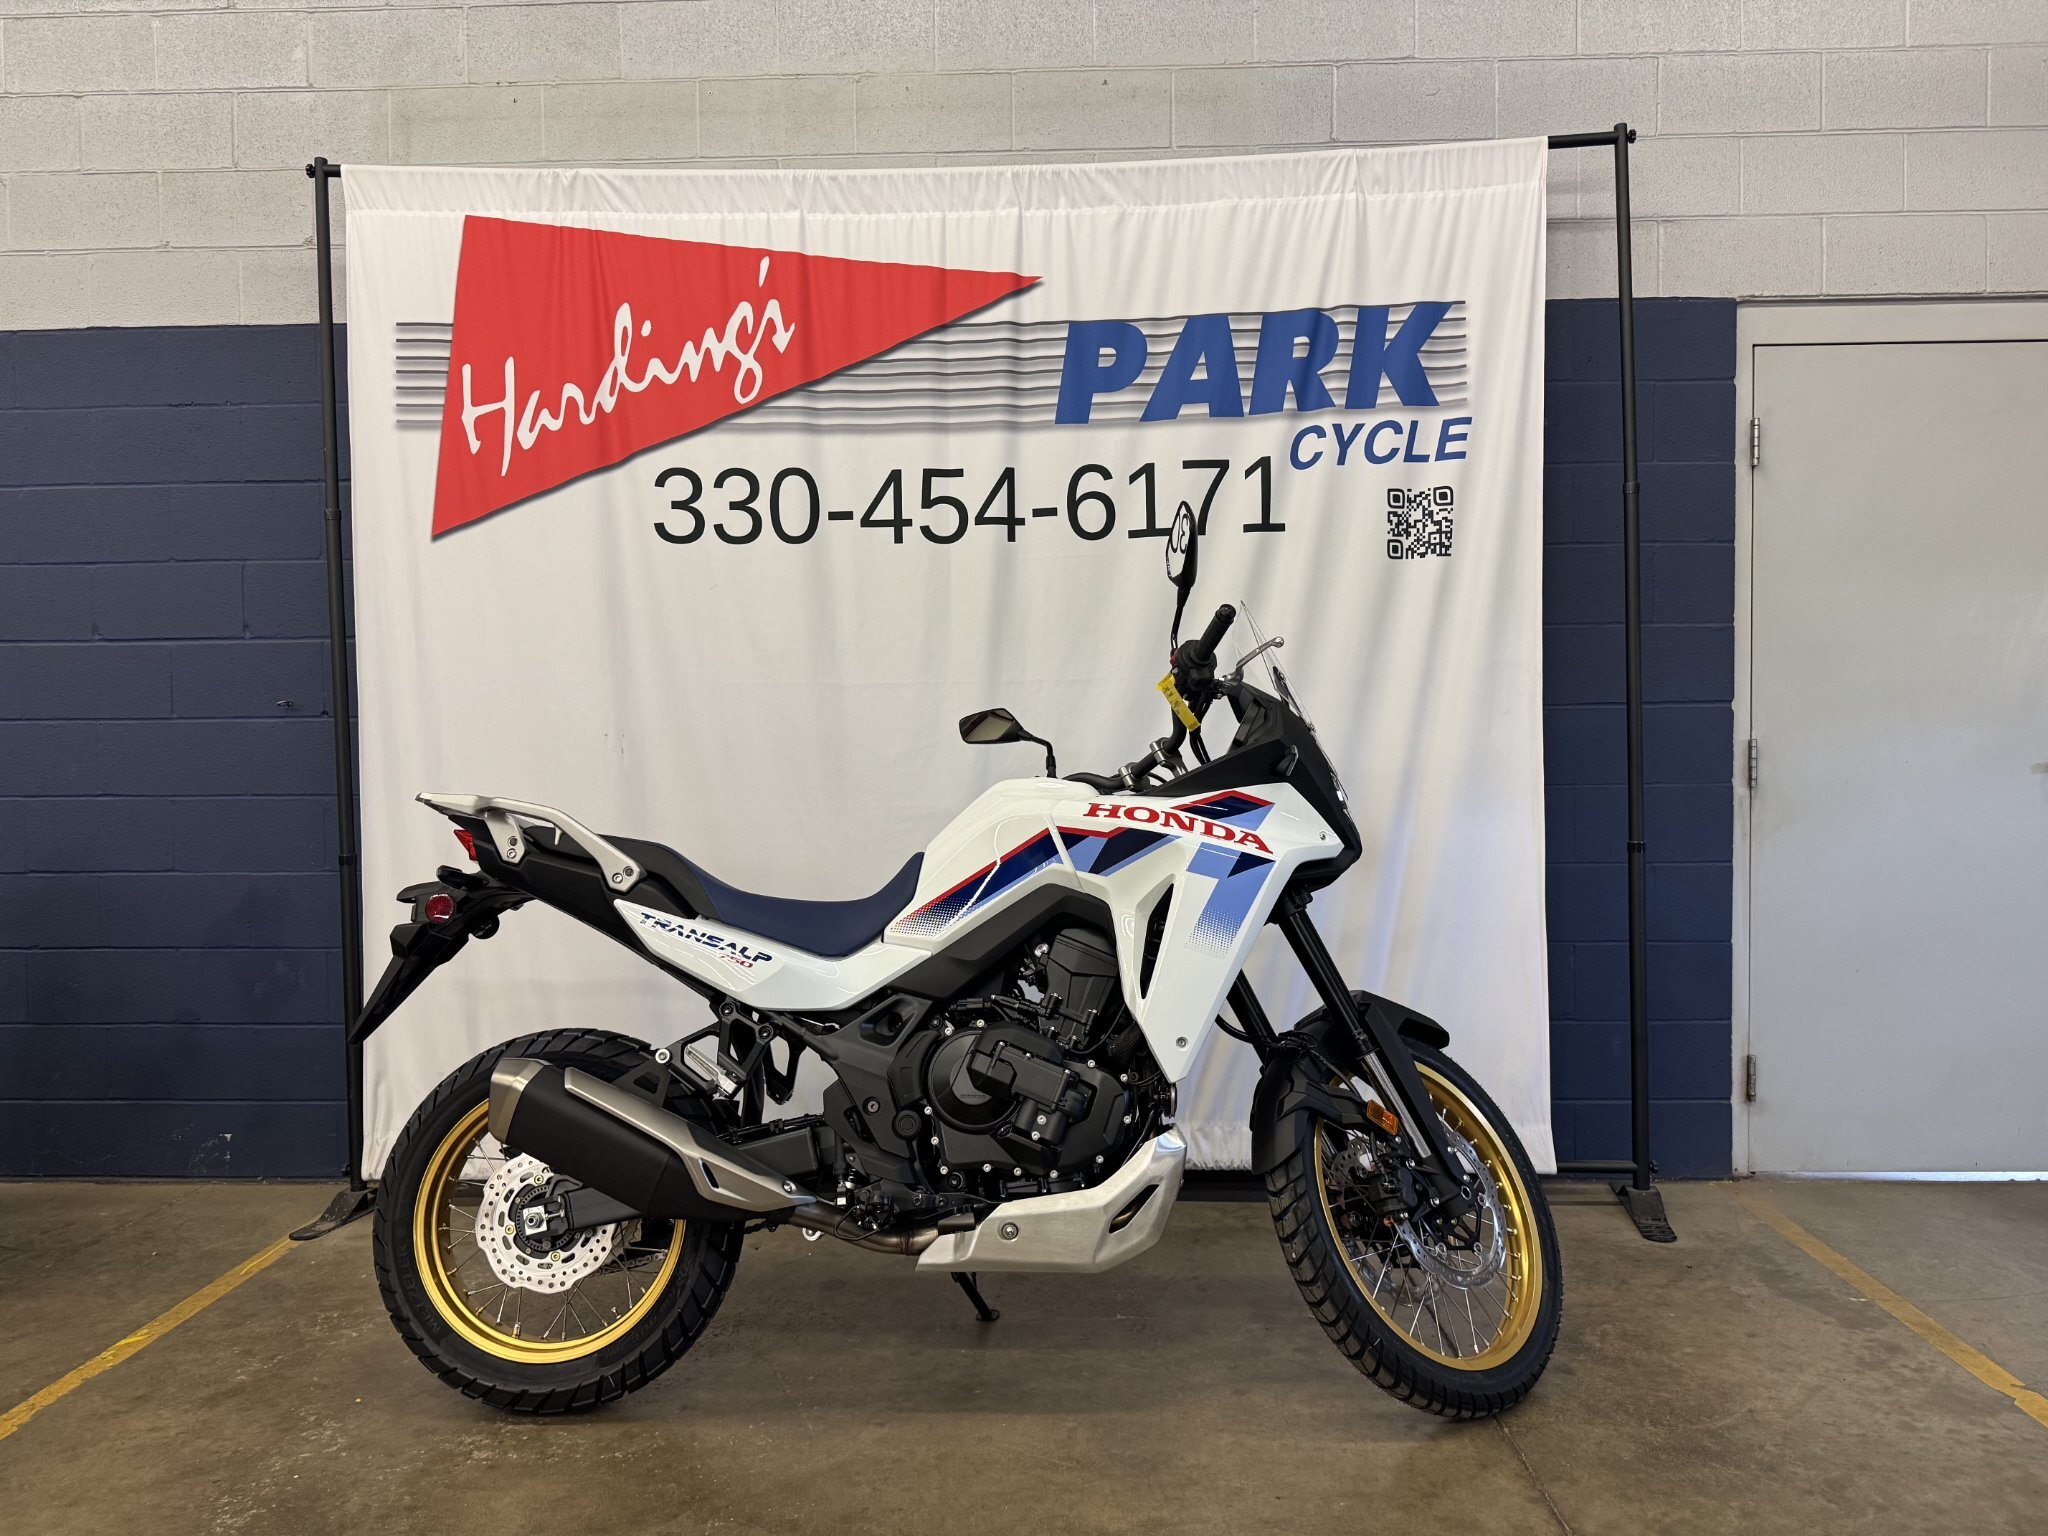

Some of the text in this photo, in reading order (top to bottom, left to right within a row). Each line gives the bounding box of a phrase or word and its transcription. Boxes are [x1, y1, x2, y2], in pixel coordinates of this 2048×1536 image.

[1055, 302, 1453, 424] PARK
[1289, 417, 1473, 470] CYCLE
[653, 455, 1286, 544] 330-454-6171
[1083, 802, 1274, 855] HONDA
[639, 912, 773, 964] TRANSALP
